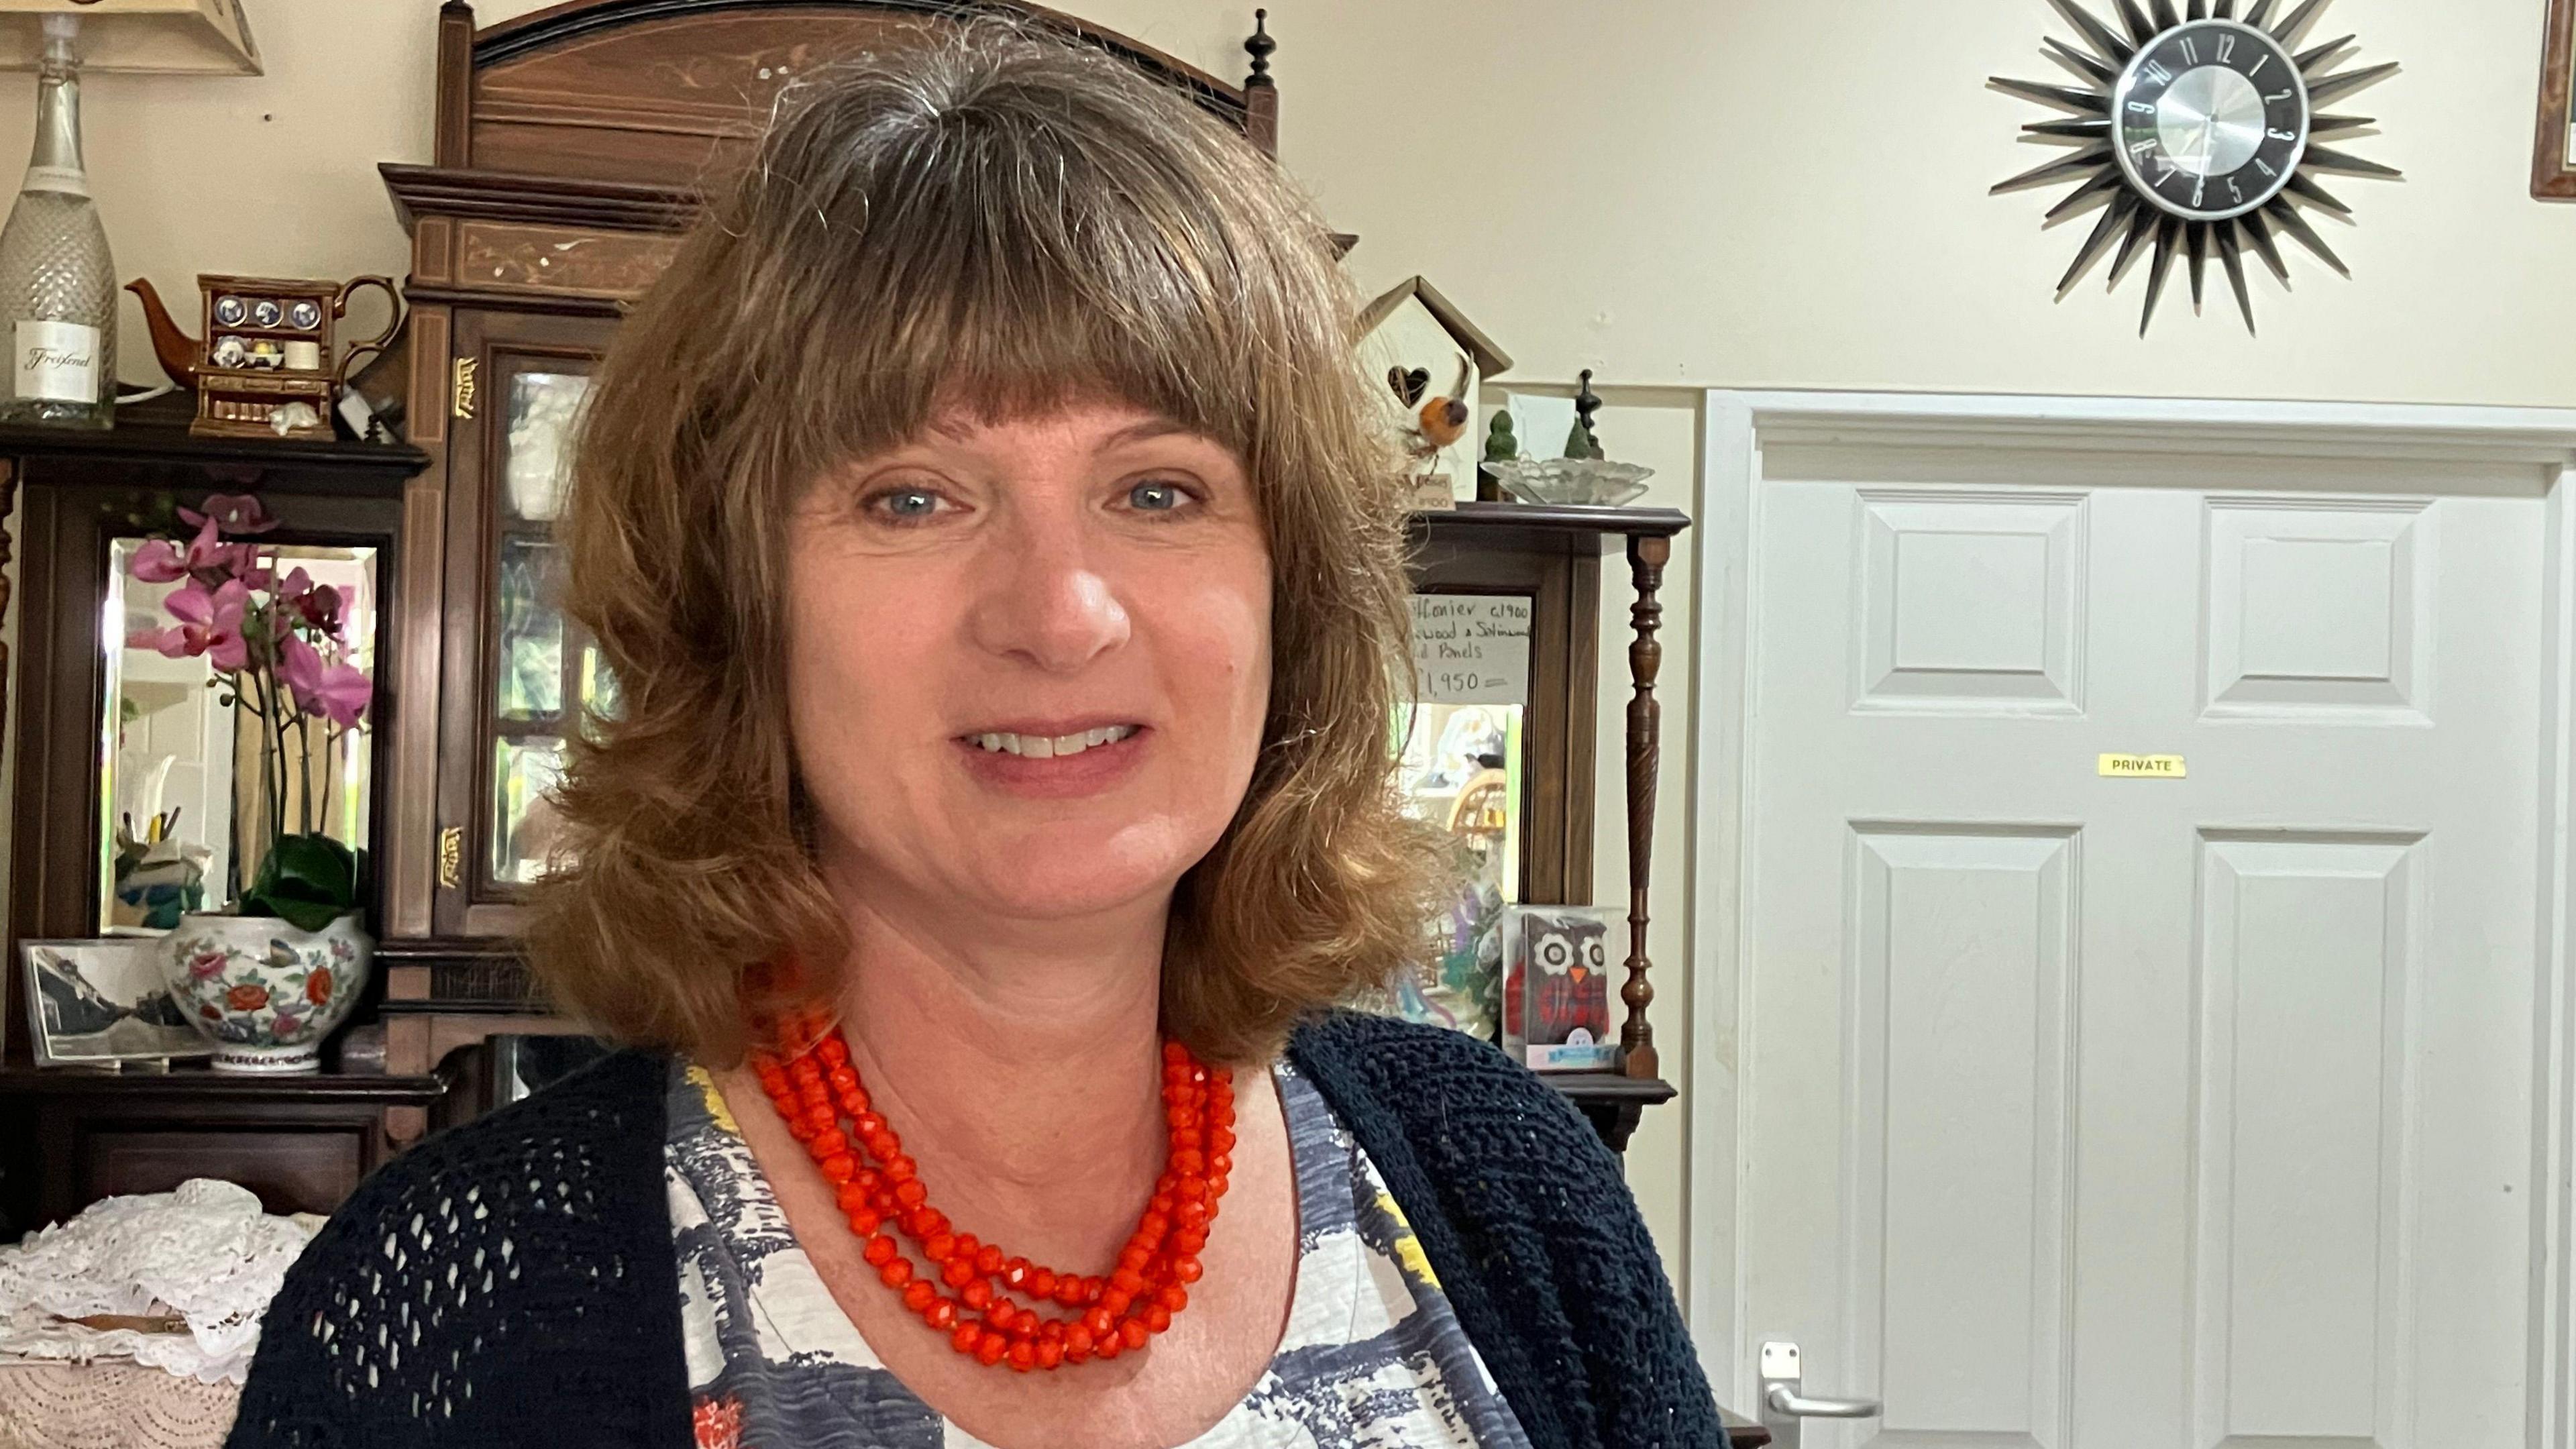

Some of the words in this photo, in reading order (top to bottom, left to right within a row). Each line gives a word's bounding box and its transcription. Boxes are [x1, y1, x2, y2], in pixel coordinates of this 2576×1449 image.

[2180, 37, 2198, 66] 11
[2216, 34, 2235, 64] 12
[2143, 59, 2172, 86] 10
[2249, 54, 2269, 77] 1
[2128, 101, 2155, 114] 9
[2264, 89, 2292, 105] 2
[2267, 127, 2295, 141] 3
[2129, 138, 2157, 154] 8
[2154, 164, 2177, 188] 7
[2255, 158, 2277, 177] 4
[2192, 178, 2206, 208] 6
[2226, 176, 2243, 204] 5
[2112, 759, 2172, 771] PRIVATE
